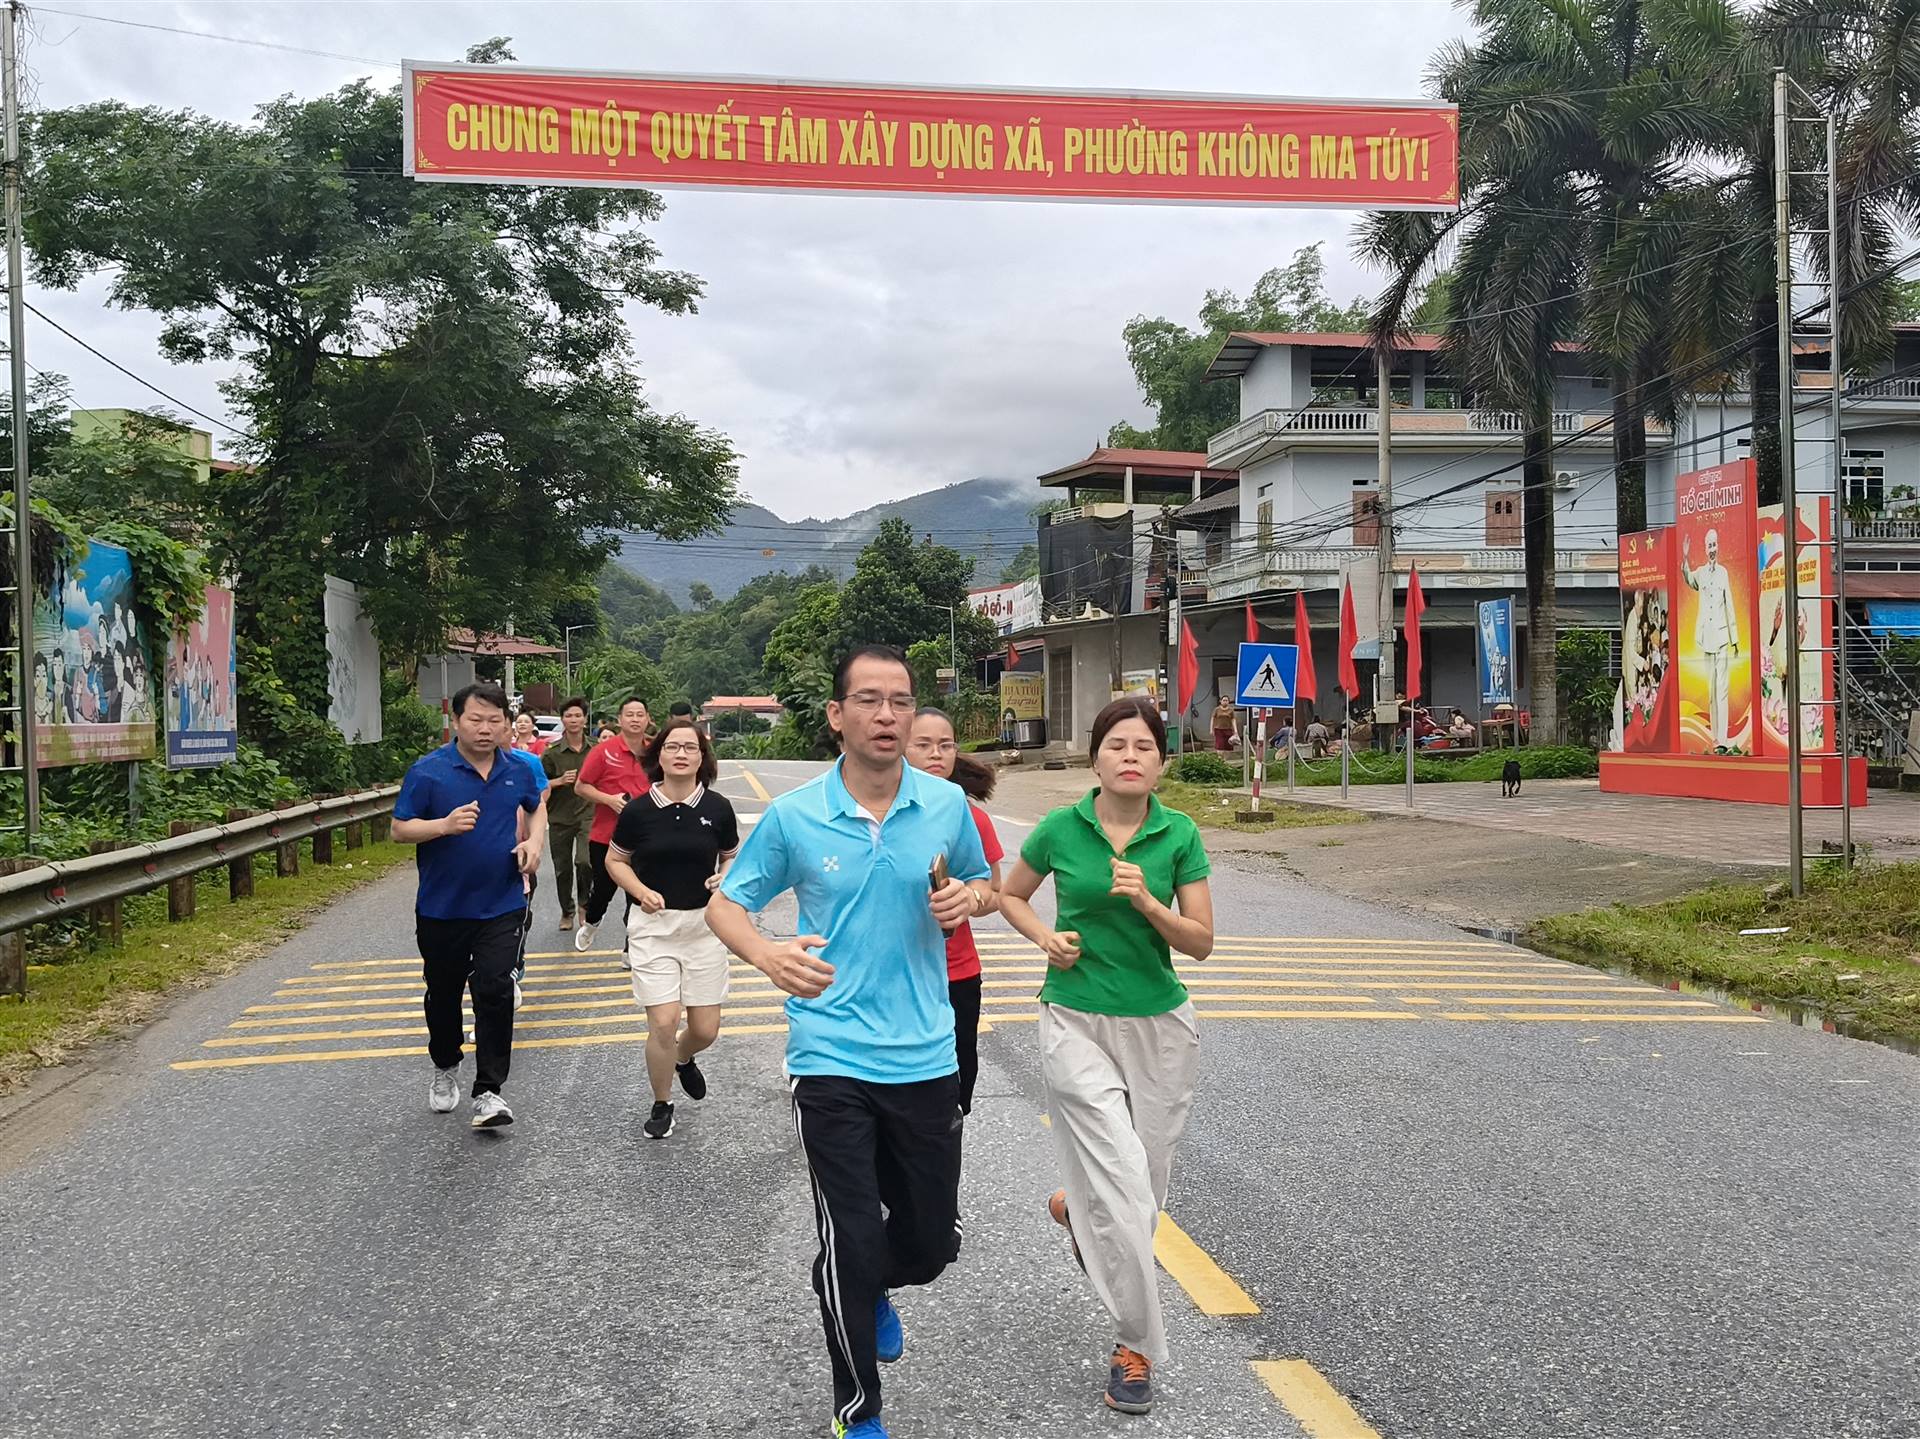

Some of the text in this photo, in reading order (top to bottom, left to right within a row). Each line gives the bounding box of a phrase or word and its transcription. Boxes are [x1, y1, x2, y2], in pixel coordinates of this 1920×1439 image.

[446, 98, 1430, 182] CHUNG MỘT QUYẾT TÂM XÂY DỰNG XÃ, PHƯỜNG KHÔNG MA TÚY!
[1697, 483, 1715, 511] CHÍ
[1715, 484, 1743, 509] MINH
